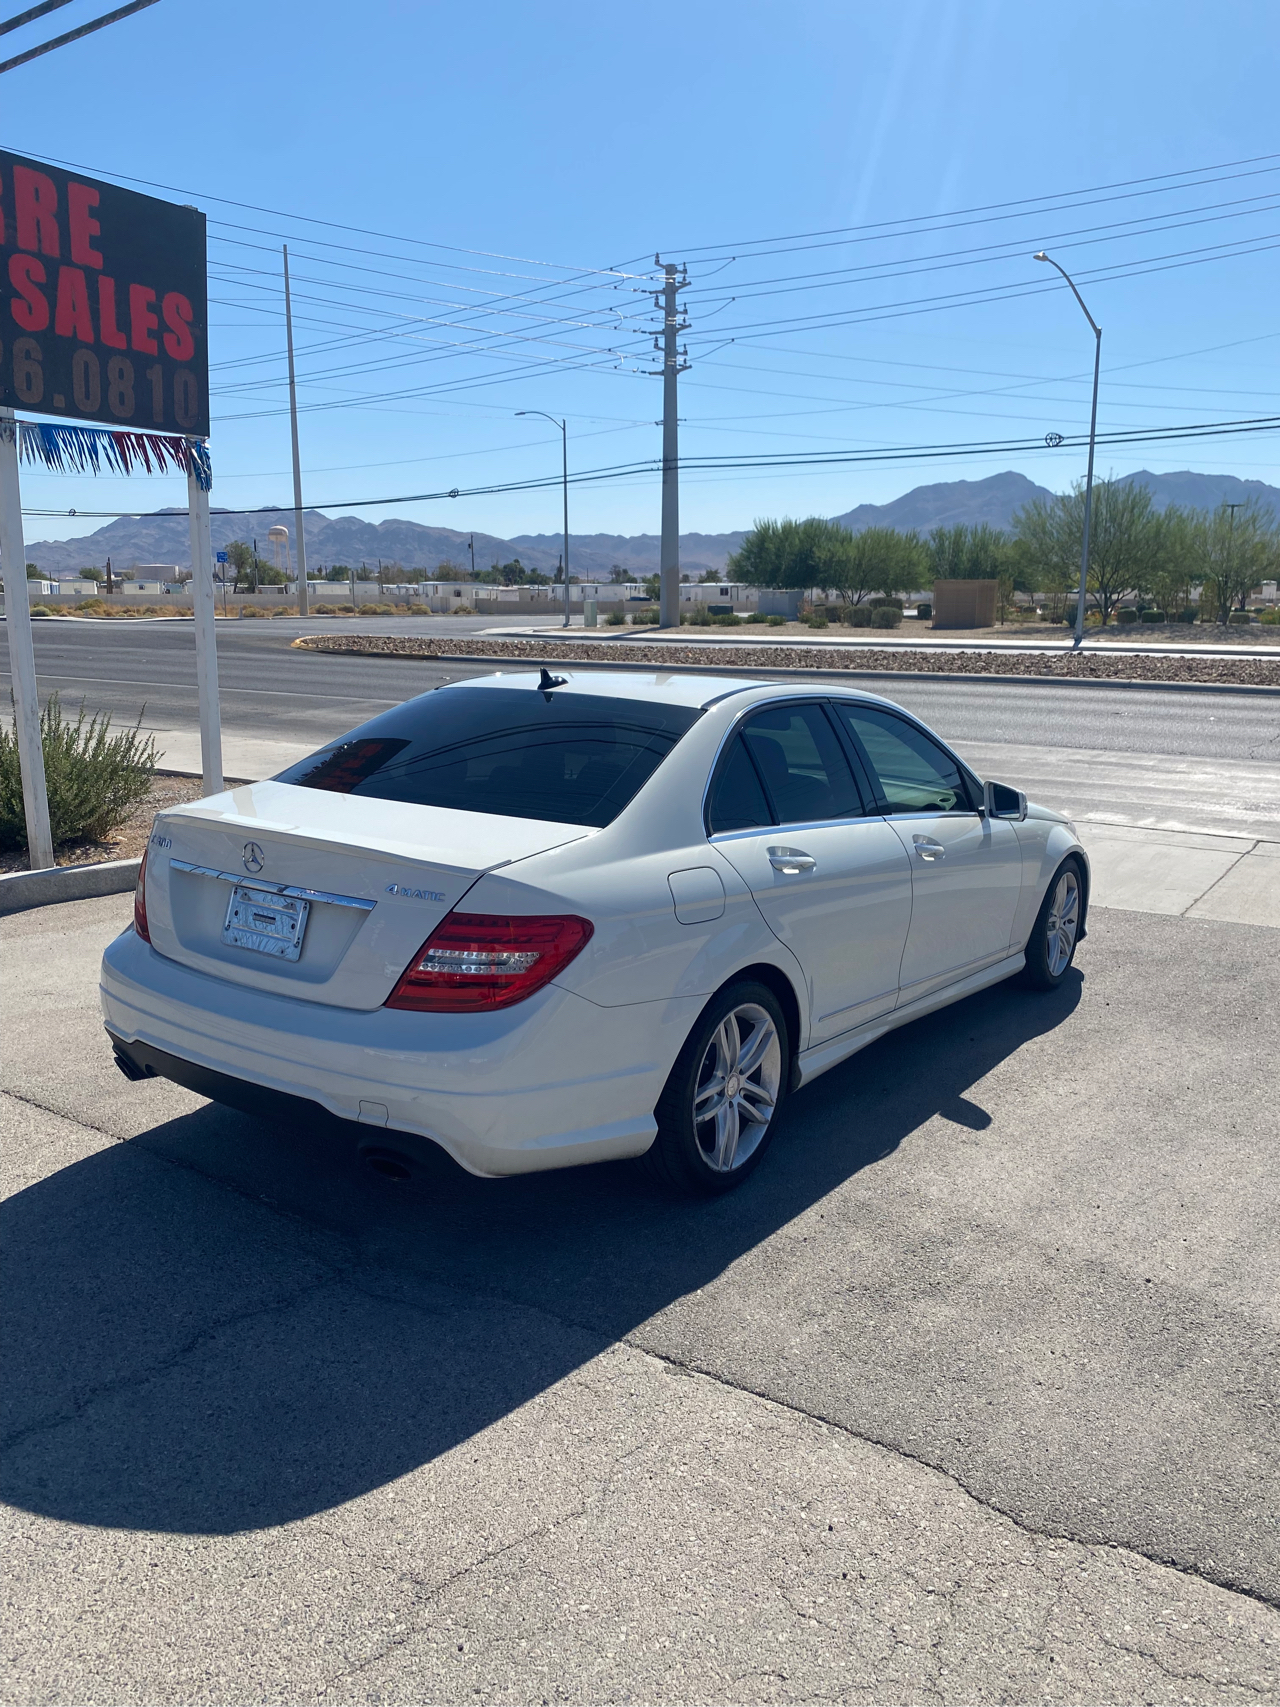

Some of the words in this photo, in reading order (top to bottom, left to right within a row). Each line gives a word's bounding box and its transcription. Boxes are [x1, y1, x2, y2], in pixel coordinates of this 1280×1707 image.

[0, 165, 103, 270] RE
[8, 253, 195, 362] SALES
[0, 337, 199, 428] 6.0810
[385, 883, 446, 902] 4MATIC
